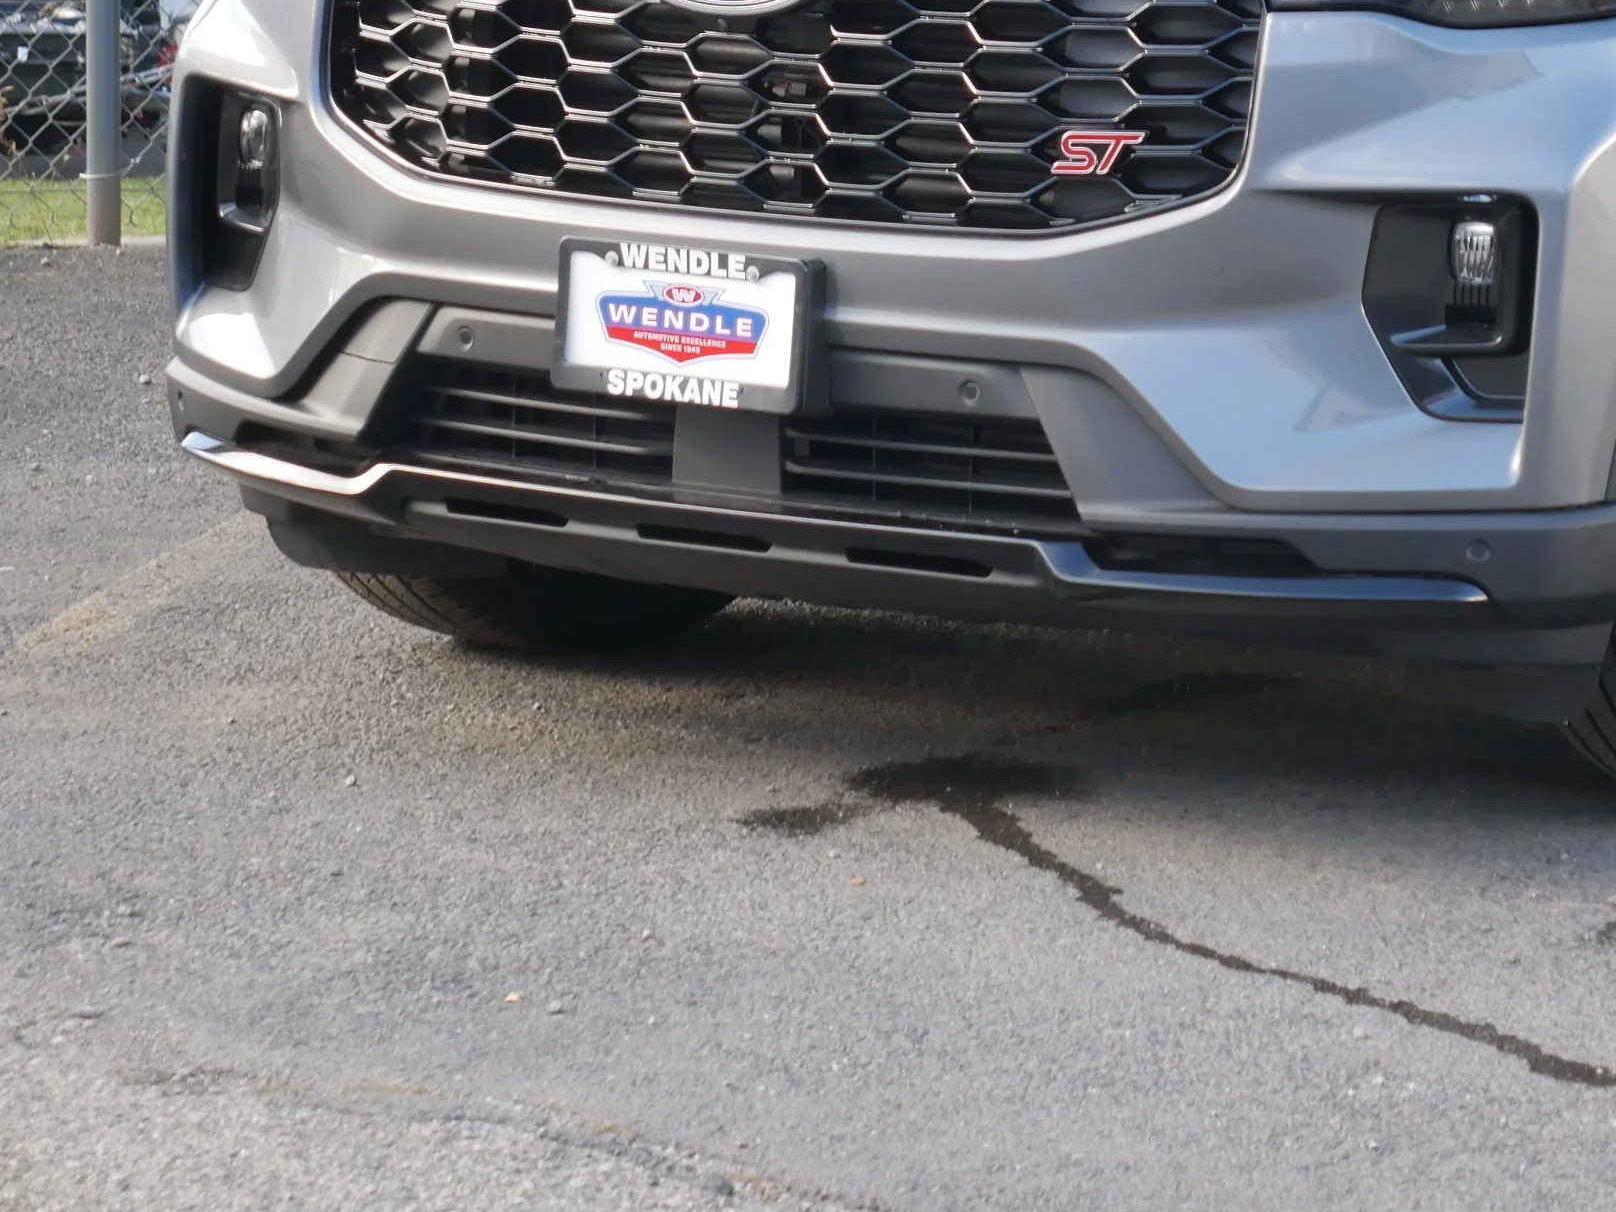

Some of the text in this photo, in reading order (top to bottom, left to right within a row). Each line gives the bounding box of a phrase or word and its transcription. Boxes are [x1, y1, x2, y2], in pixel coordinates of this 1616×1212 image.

[1050, 130, 1148, 176] ST
[620, 243, 746, 280] WENDLE
[609, 303, 753, 338] WENDLE
[633, 331, 727, 349] AUTOMOTIVE EXCELLENCE
[660, 342, 682, 353] SINCE
[606, 368, 739, 408] SPOKANE
